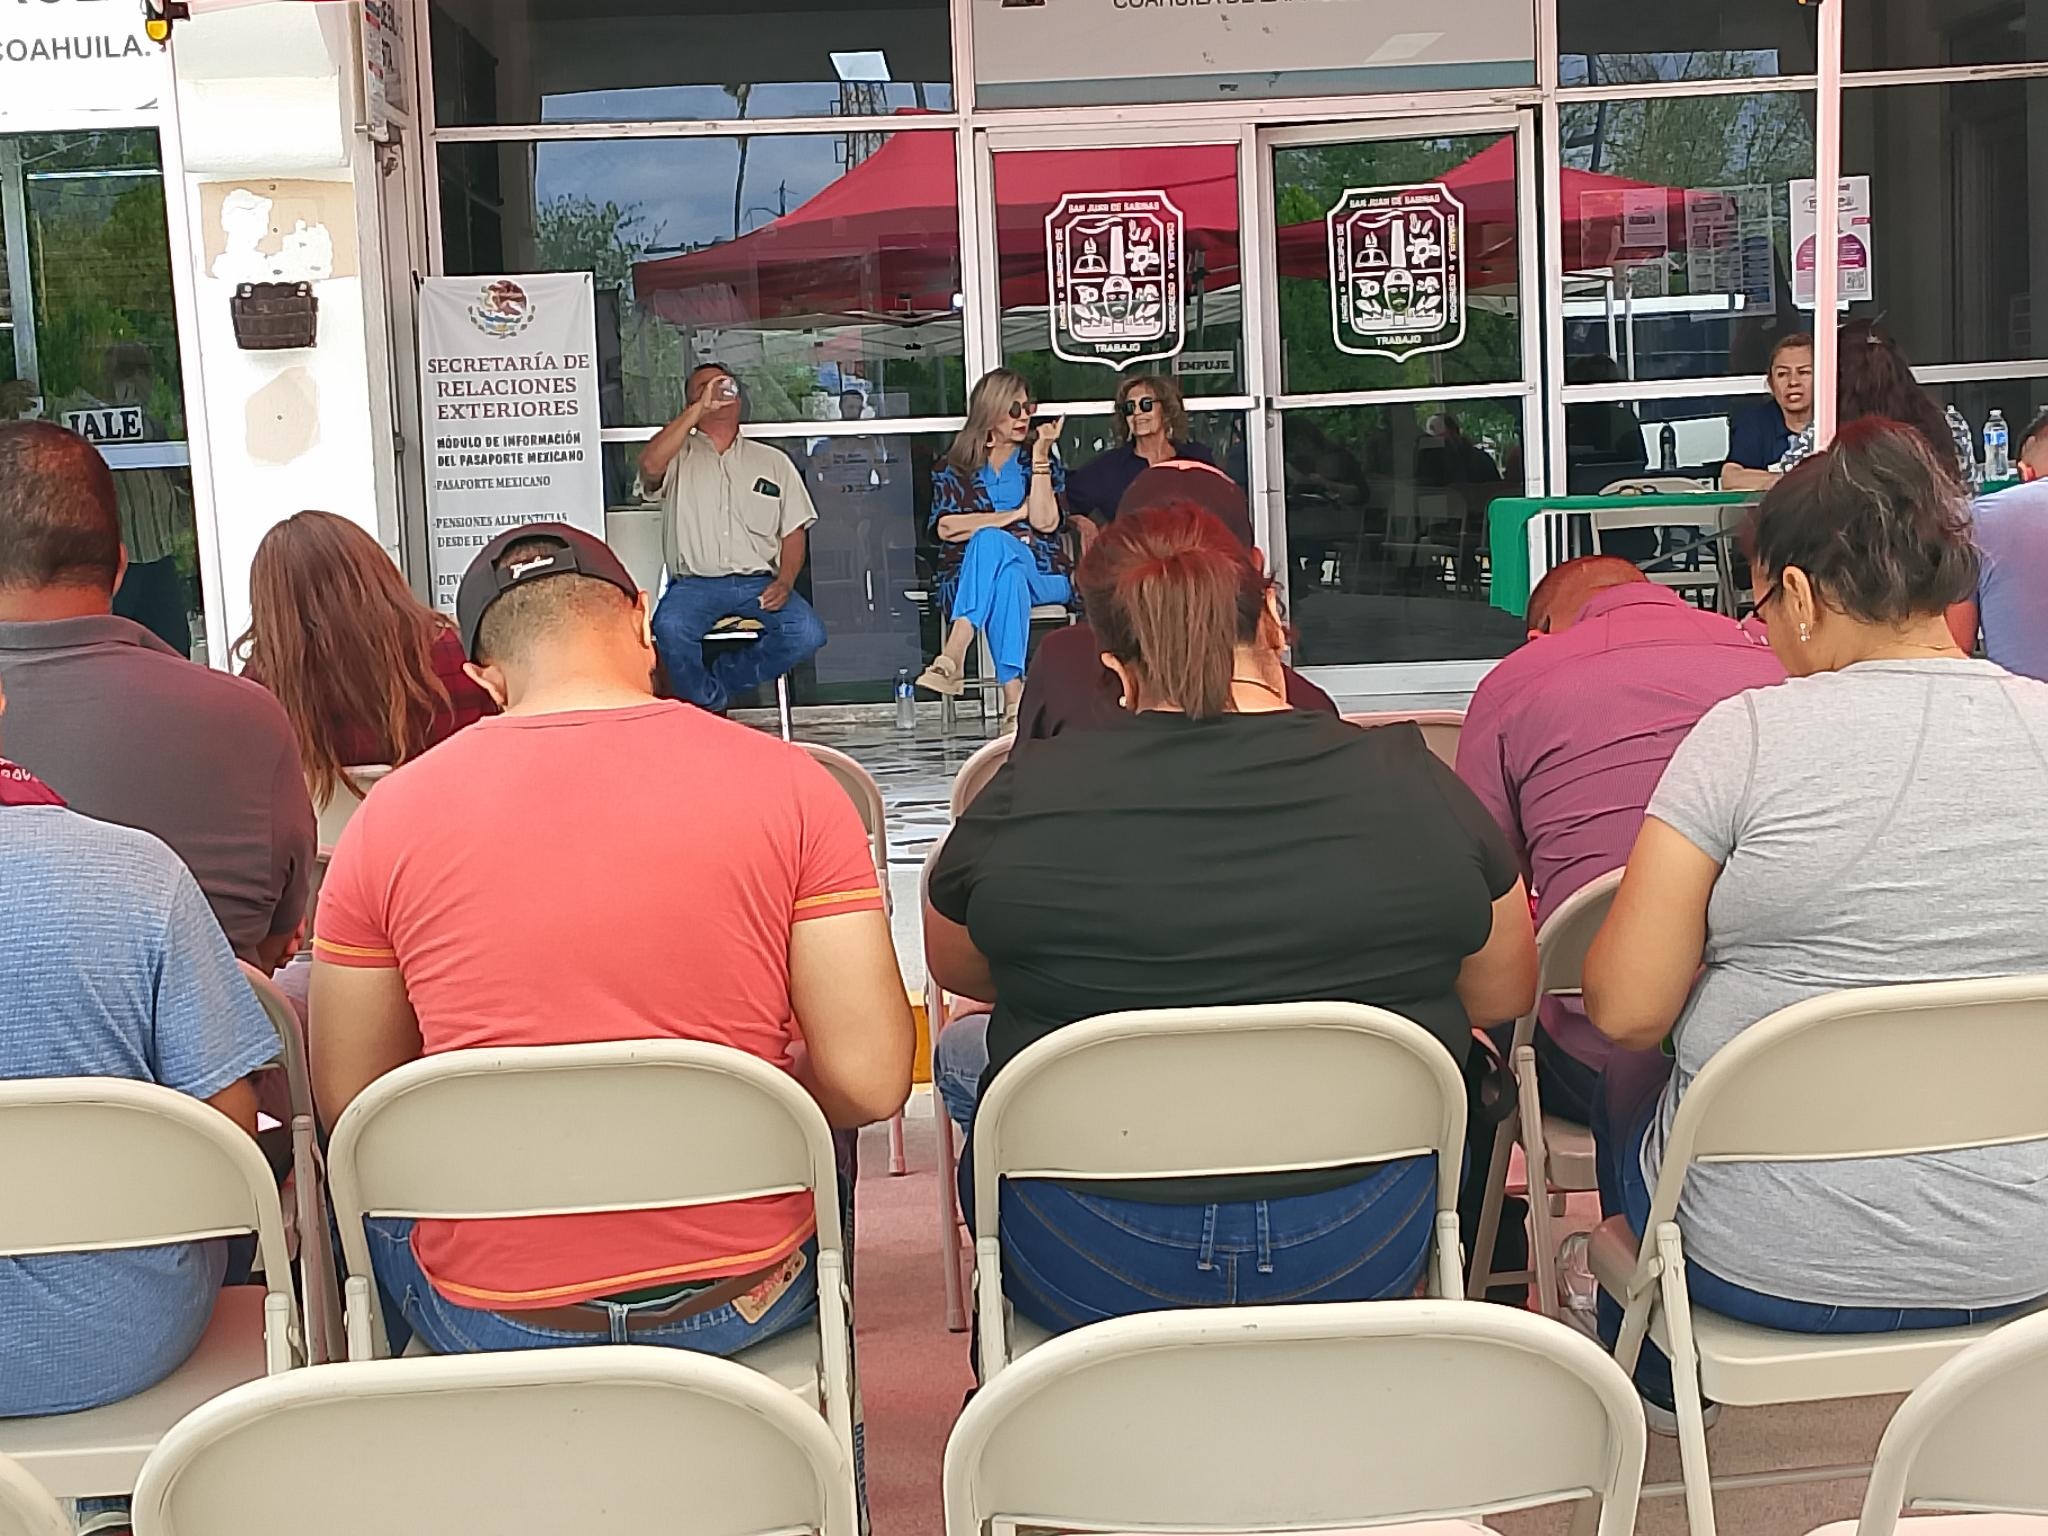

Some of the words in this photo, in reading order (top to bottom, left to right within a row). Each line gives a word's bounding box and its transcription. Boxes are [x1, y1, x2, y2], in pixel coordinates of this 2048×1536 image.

[0, 34, 151, 61] OAHUILA.
[1094, 343, 1141, 353] TRABAJO
[1375, 335, 1422, 346] TRABAJO
[427, 351, 559, 374] SECRETARÍA
[563, 354, 590, 369] DE
[1178, 360, 1231, 371] EMPUJE
[436, 377, 577, 398] RELACIONES
[436, 399, 579, 420] EXTERIORES
[436, 435, 482, 449] MÓDULO
[485, 436, 500, 448] DE
[503, 430, 581, 447] INFORMACIÓN
[437, 456, 457, 467] DEL
[459, 453, 524, 467] PASAPORTE
[527, 450, 584, 464] MEXICANO
[496, 475, 551, 489] MEXICANO
[437, 537, 471, 548] DESDE
[472, 536, 485, 546] EL
